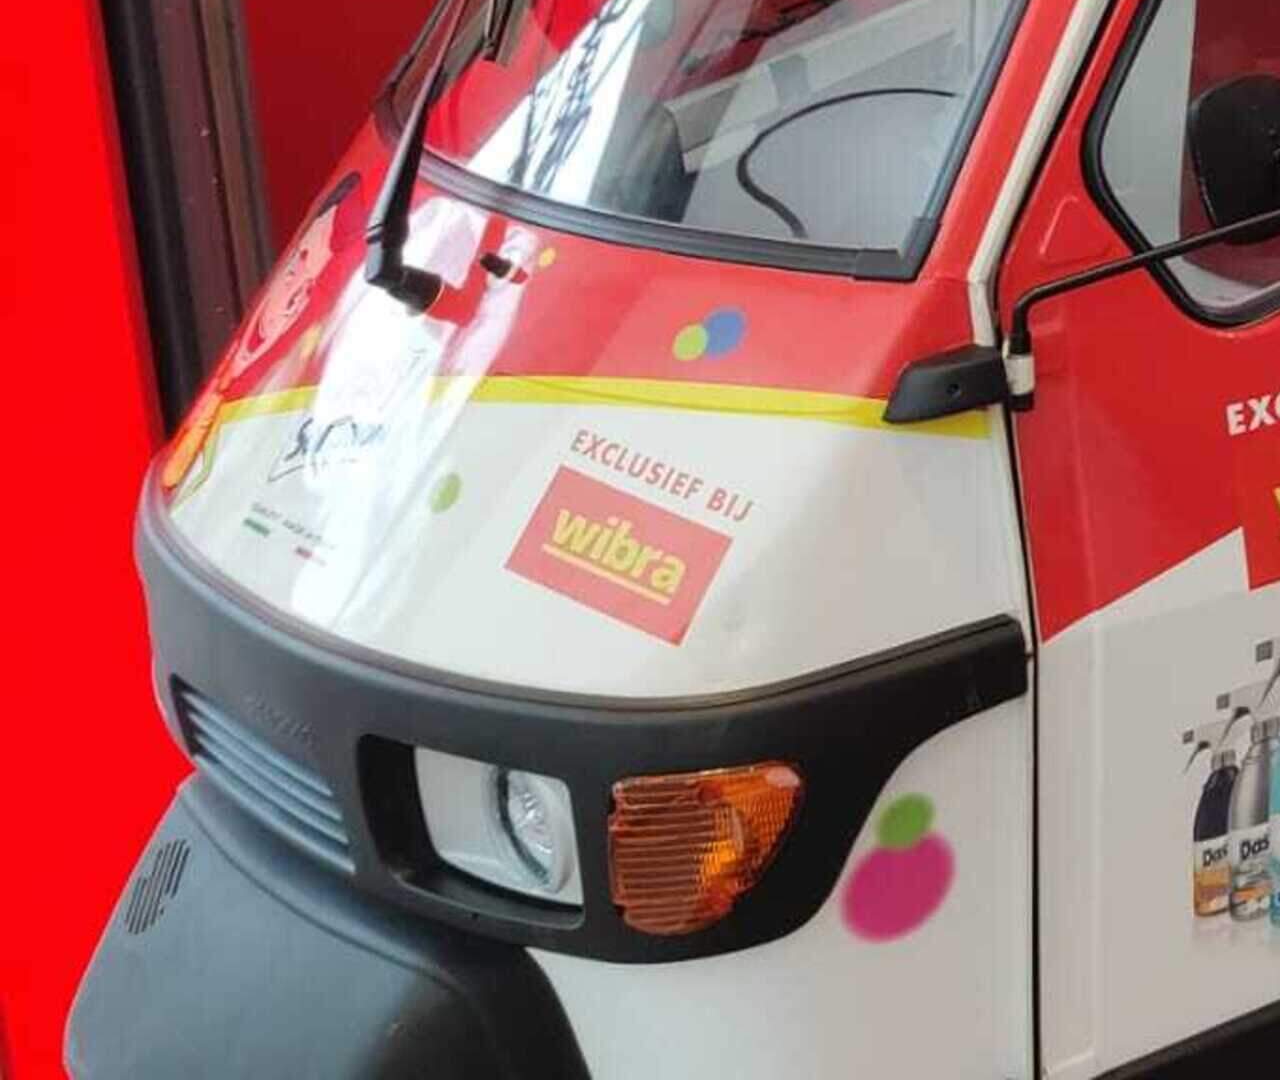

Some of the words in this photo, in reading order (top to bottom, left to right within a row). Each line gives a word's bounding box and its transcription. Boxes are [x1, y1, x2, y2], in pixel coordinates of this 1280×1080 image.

[569, 426, 704, 501] EXCLUSIEF
[706, 481, 758, 524] BIJ
[549, 502, 688, 598] wibra
[1202, 844, 1229, 868] Das
[1241, 834, 1270, 861] Das
